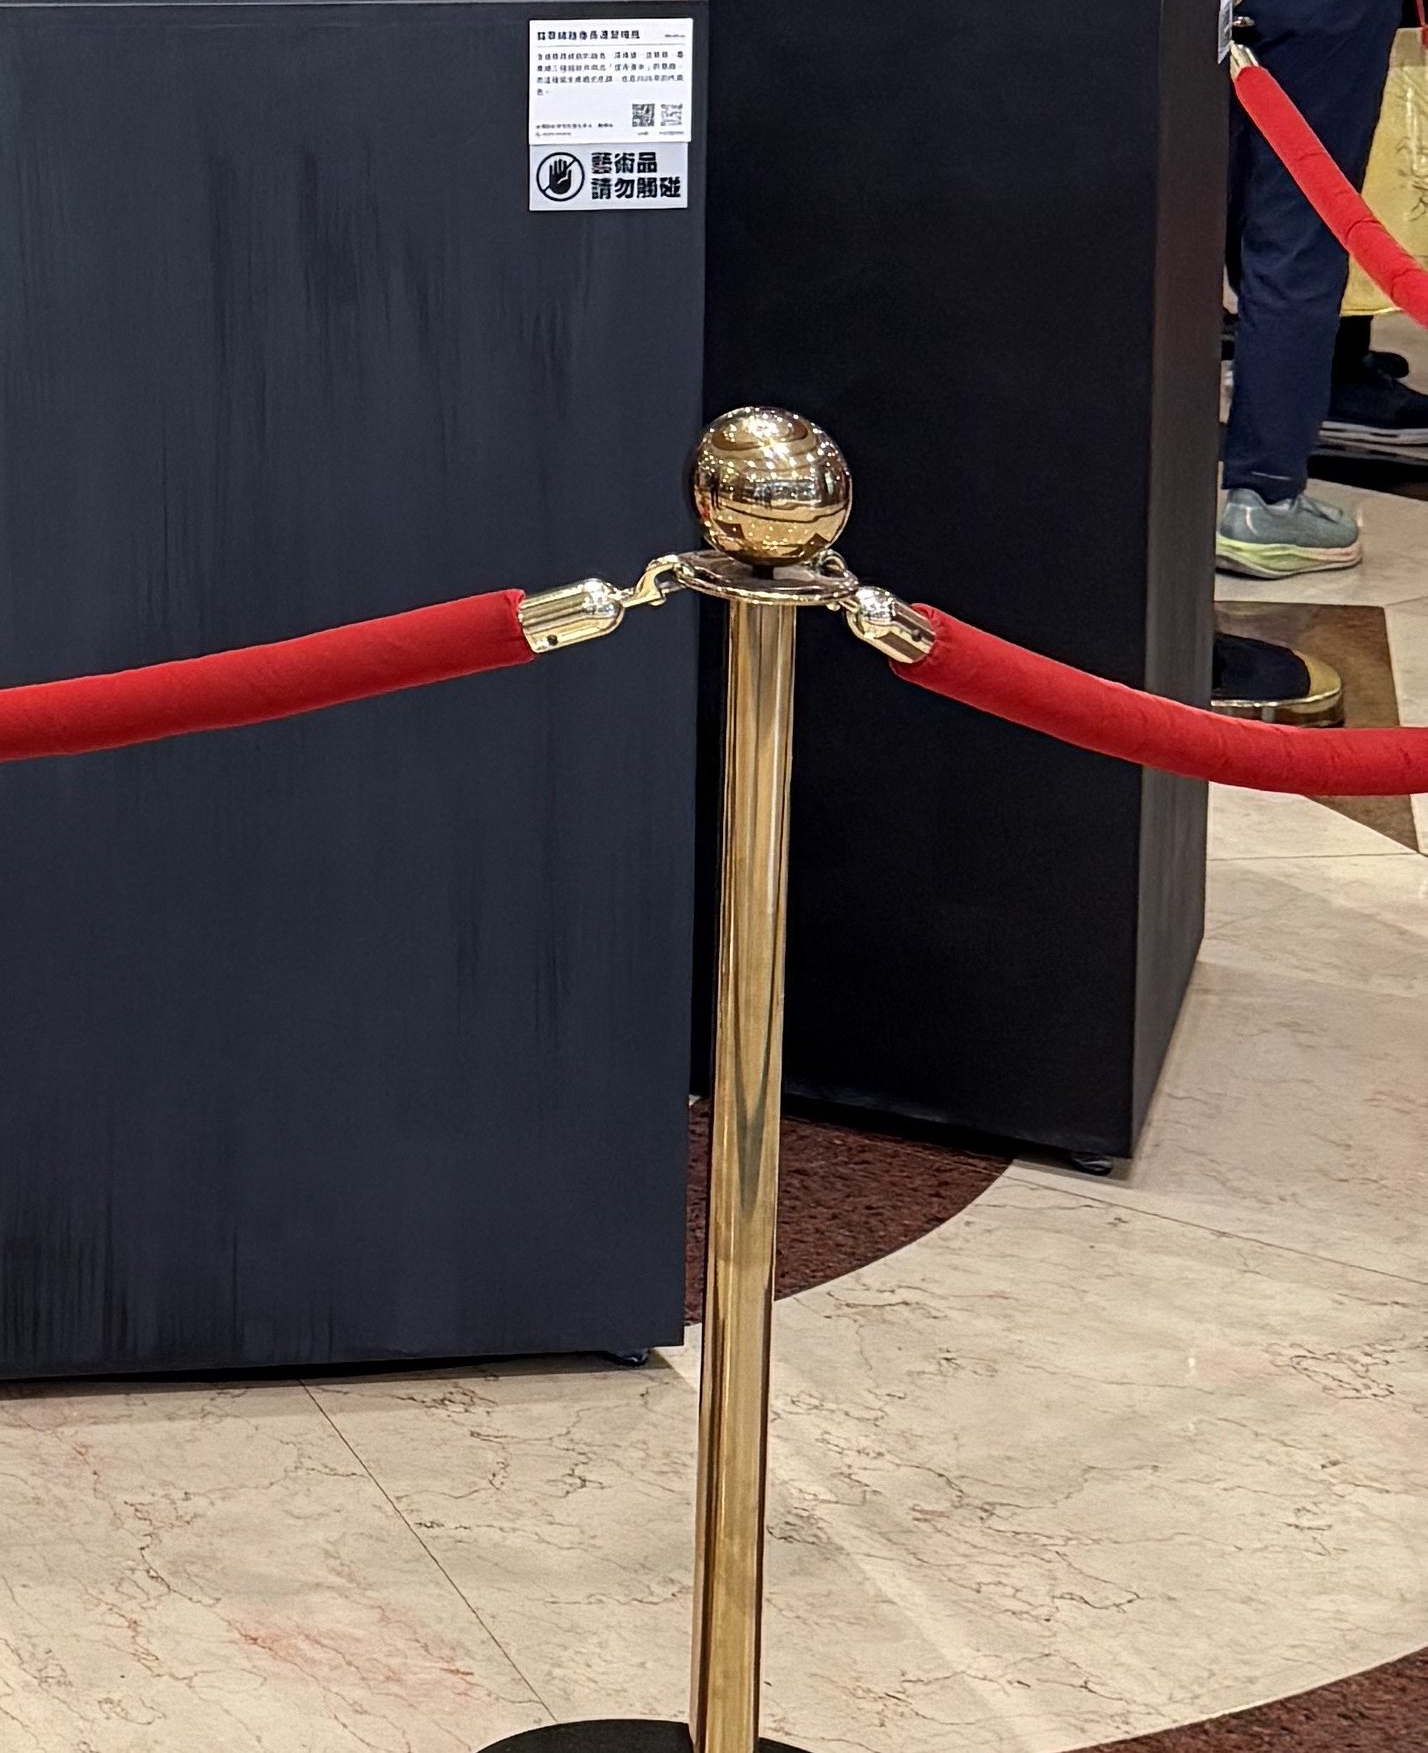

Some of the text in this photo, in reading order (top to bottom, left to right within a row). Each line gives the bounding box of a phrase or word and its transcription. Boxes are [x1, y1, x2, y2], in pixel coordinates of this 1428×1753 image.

[591, 152, 657, 174] 藝術品
[591, 176, 681, 200] 請勿觸碰
